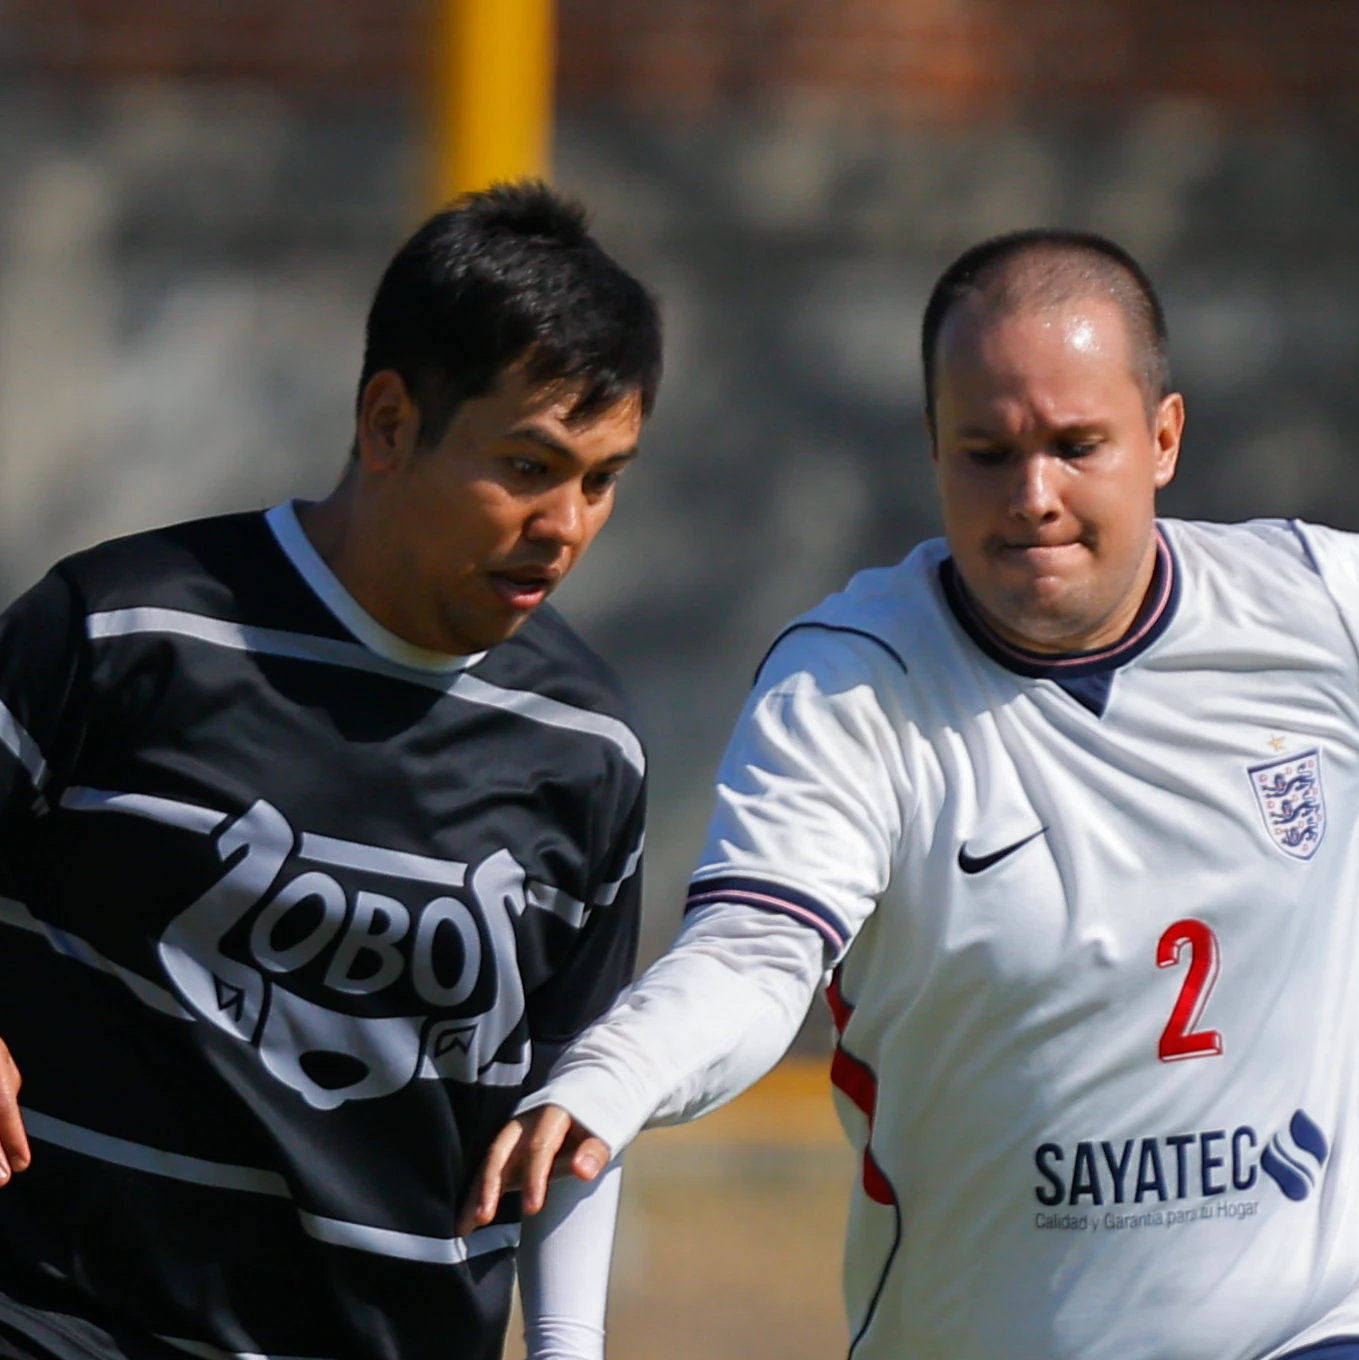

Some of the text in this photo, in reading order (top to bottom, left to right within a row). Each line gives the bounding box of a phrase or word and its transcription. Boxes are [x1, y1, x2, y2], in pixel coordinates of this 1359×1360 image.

[158, 798, 528, 1084] LOBOS
[1156, 918, 1223, 1063] 2
[1034, 1125, 1258, 1206] SAYATEC
[1035, 1212, 1088, 1231] Calidad
[1165, 1207, 1197, 1228] para
[1216, 1199, 1260, 1219] Hogar
